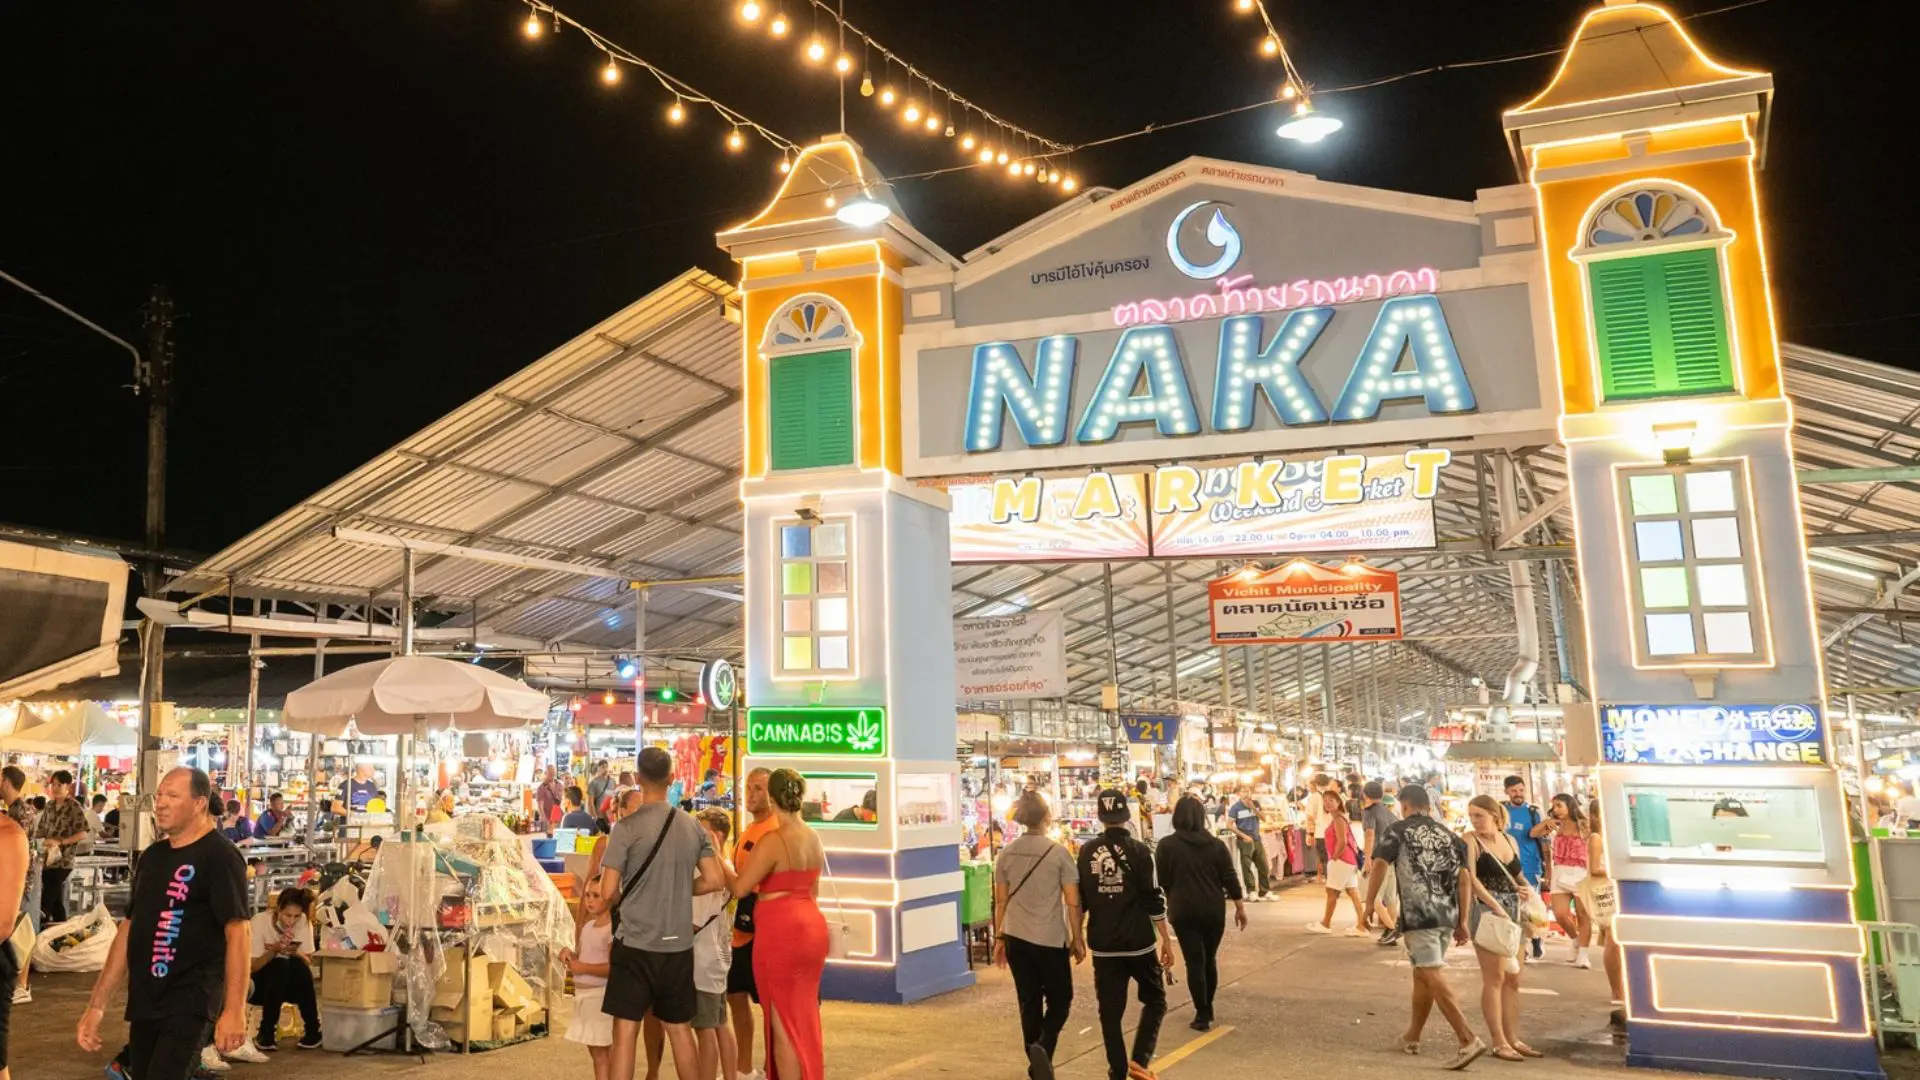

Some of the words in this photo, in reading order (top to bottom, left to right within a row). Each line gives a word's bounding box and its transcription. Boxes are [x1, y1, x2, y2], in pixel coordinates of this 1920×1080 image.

[1031, 258, 1149, 284] บารมีไอ้ไข่คุ้มครอง
[1113, 267, 1437, 327] ตลาดท้ายรถนาคา
[965, 294, 1478, 453] NAKA
[990, 448, 1451, 524] MARKET
[1222, 587, 1271, 598] Vichit
[1276, 583, 1383, 595] Municipality
[1223, 593, 1385, 615] ตลาดนัดน่าซื้อ
[752, 722, 843, 744] CANNABIS
[1139, 721, 1164, 740] 21
[151, 864, 195, 978] Off-White
